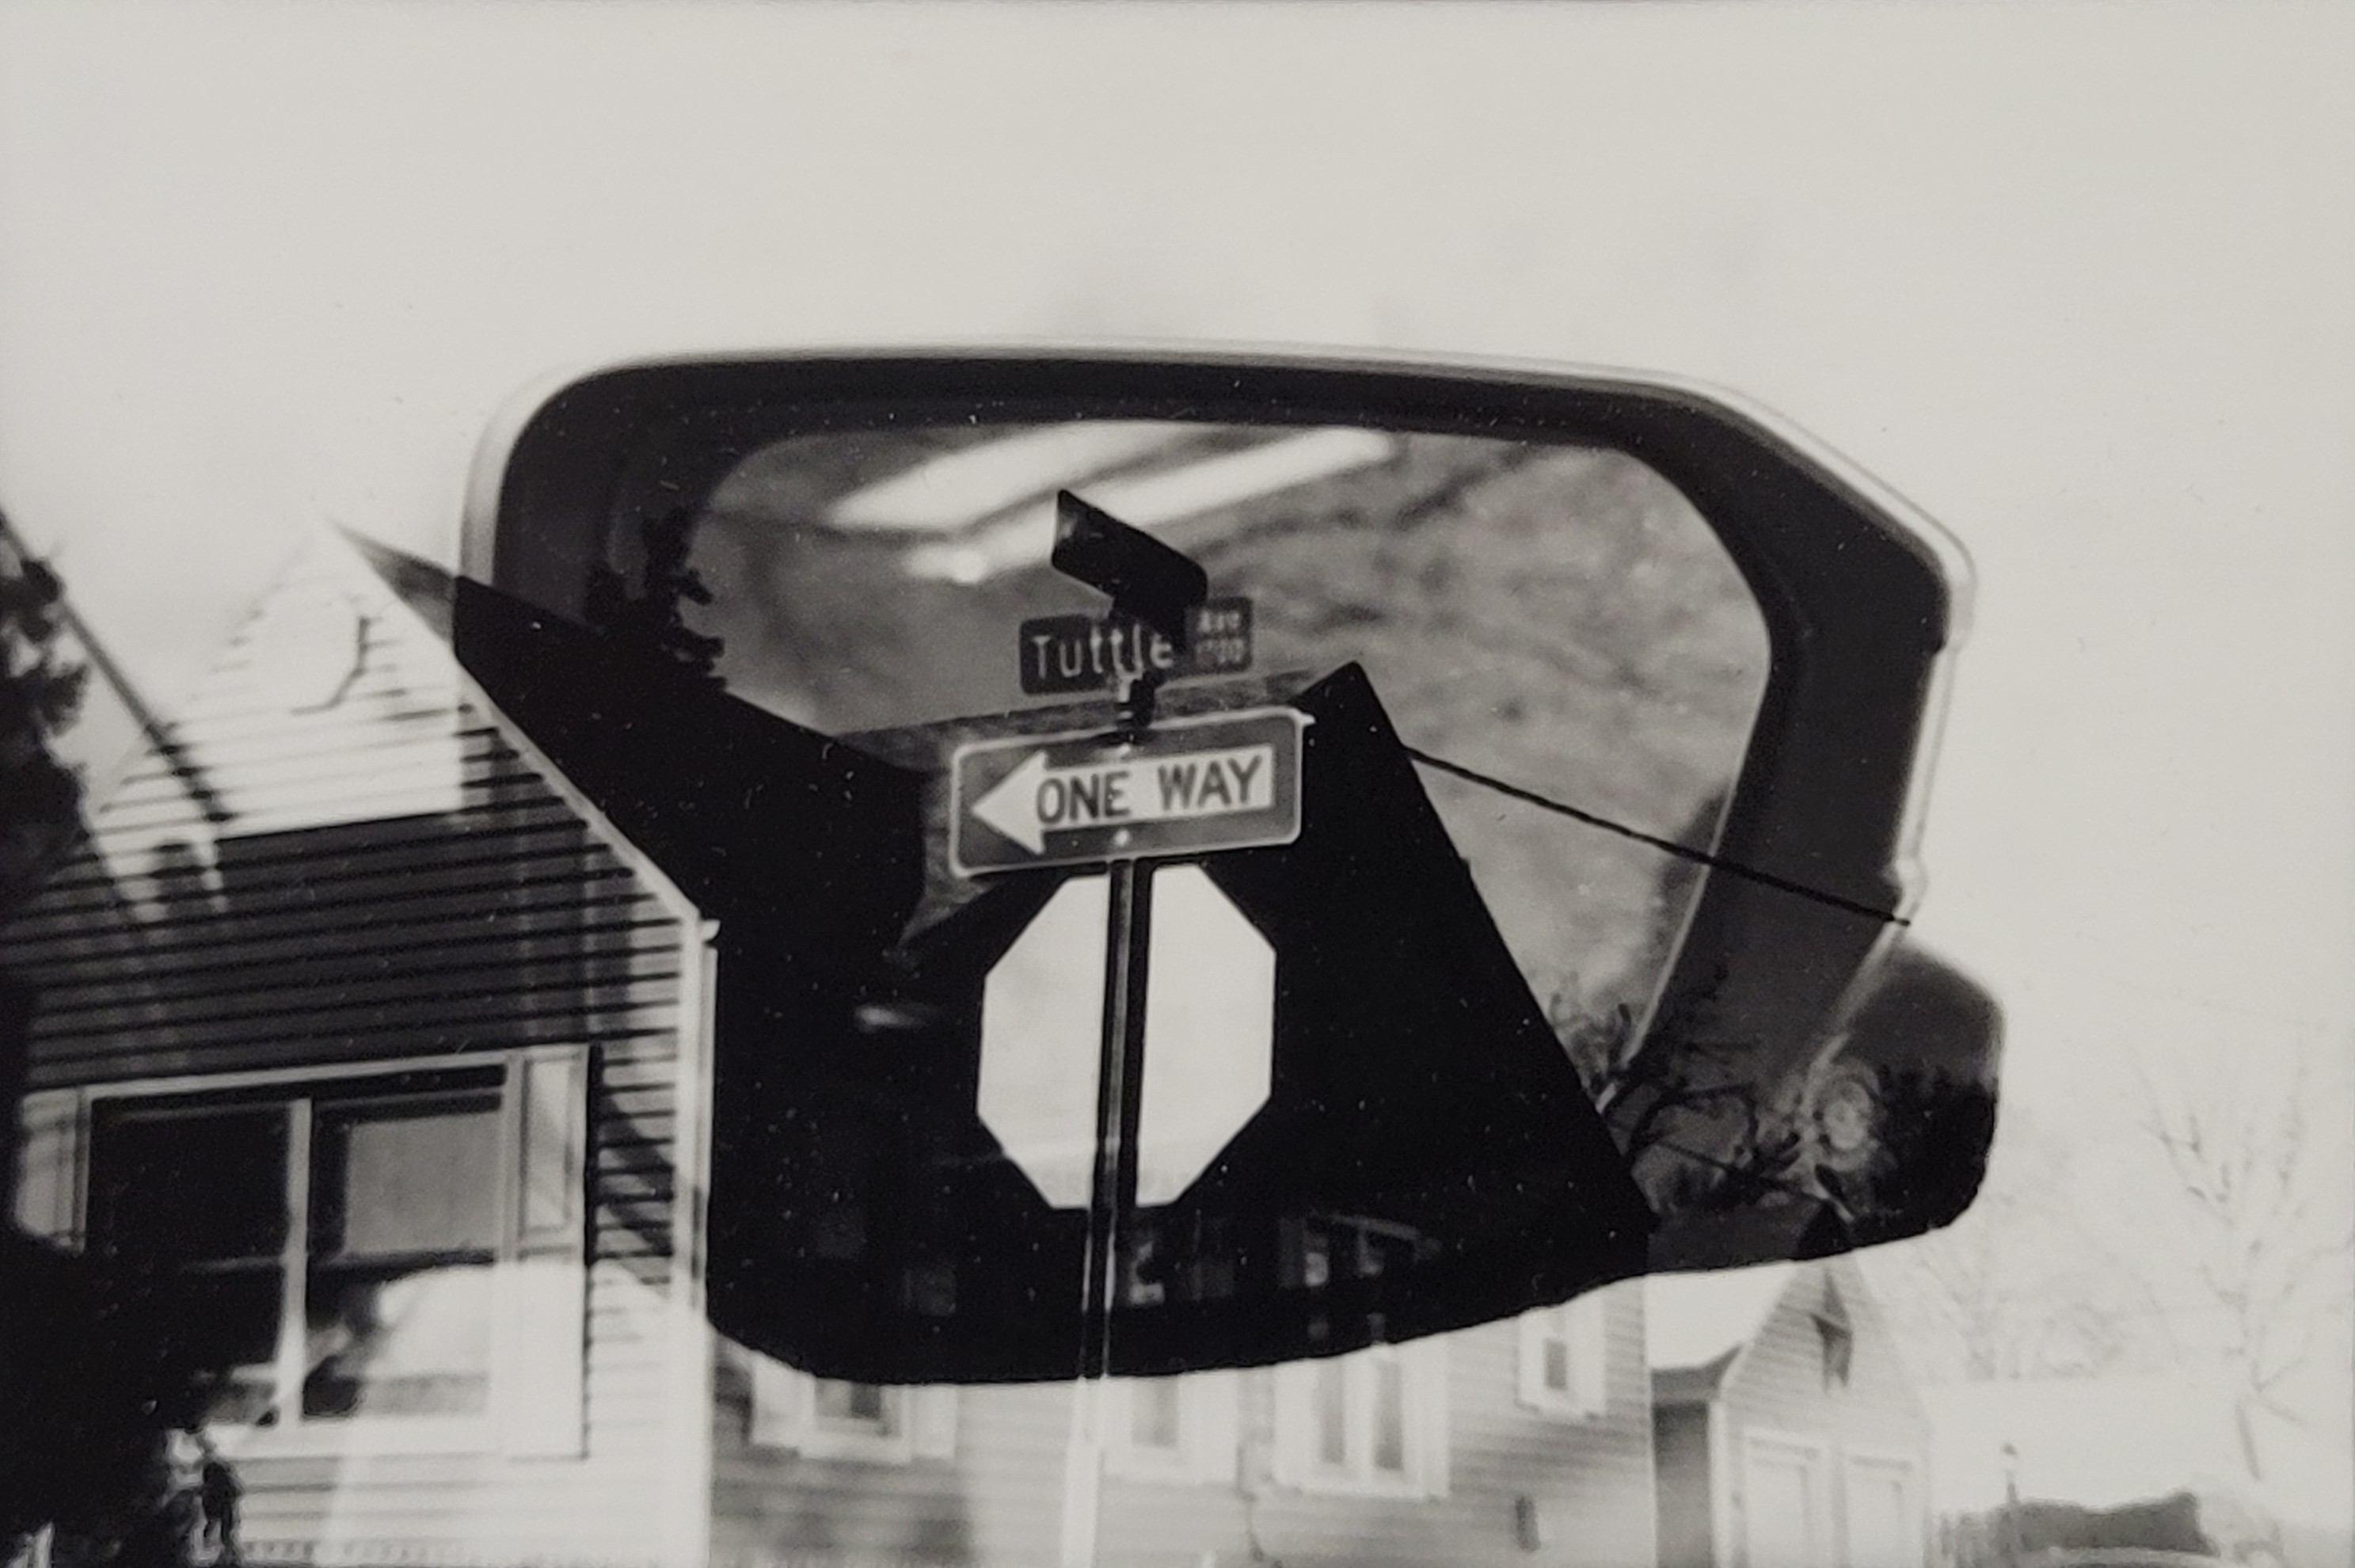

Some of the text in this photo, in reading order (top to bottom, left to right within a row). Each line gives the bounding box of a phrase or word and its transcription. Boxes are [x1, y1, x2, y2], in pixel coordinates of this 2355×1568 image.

[1033, 624, 1174, 679] Tuttle
[1037, 755, 1262, 824] ONE WAY
